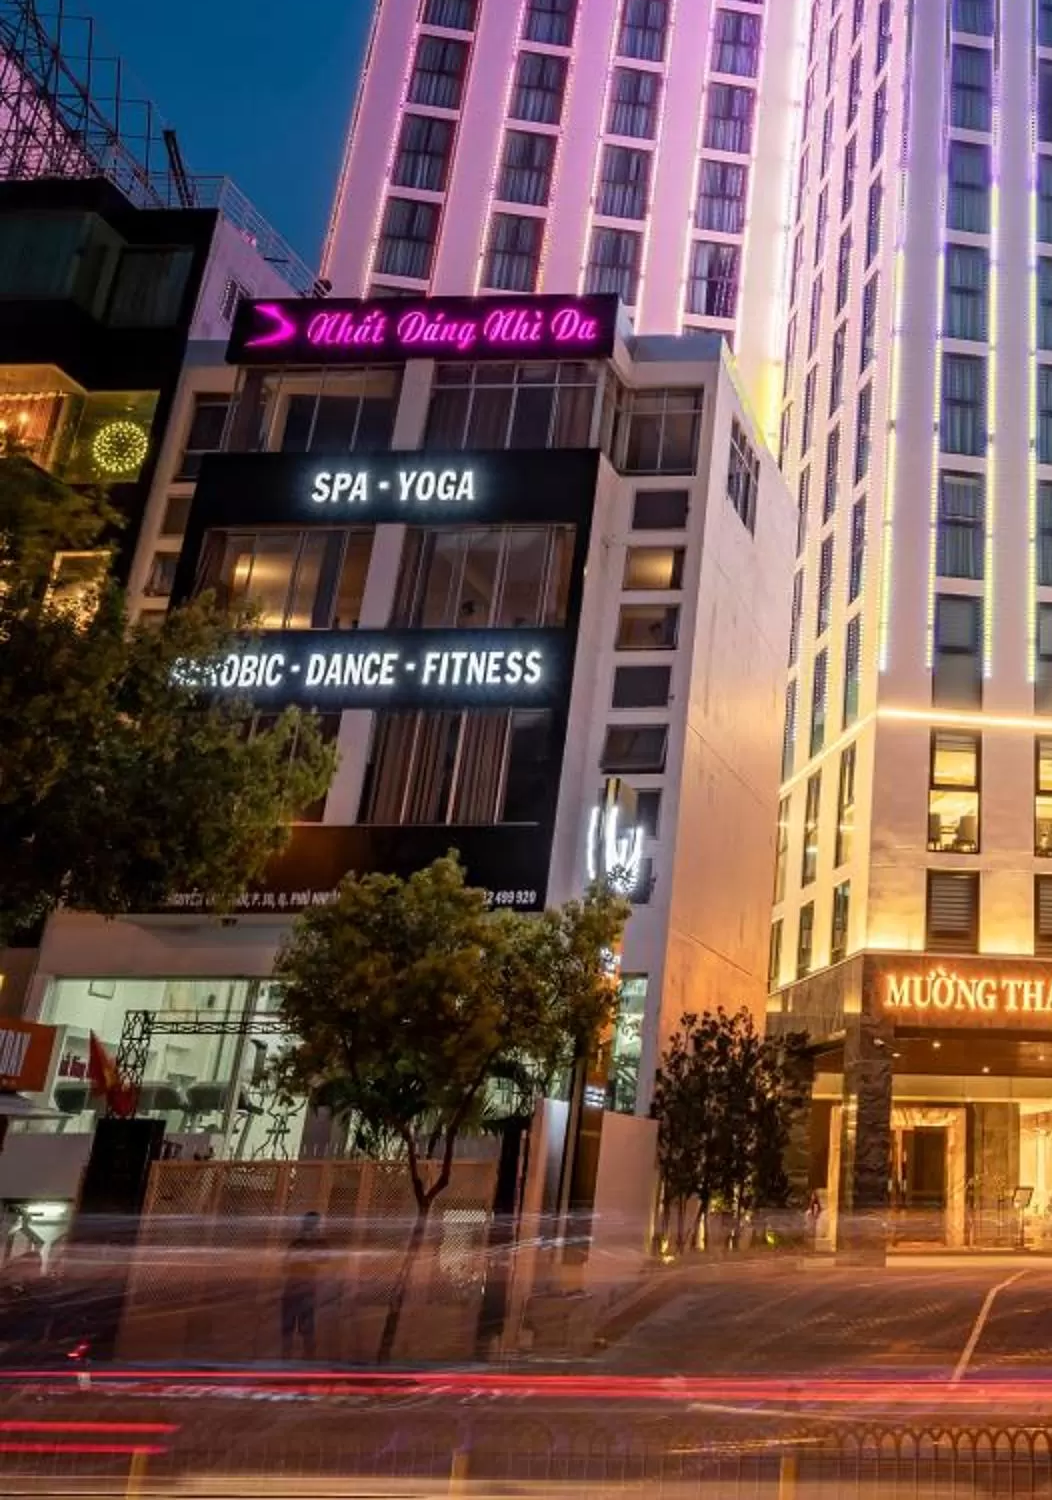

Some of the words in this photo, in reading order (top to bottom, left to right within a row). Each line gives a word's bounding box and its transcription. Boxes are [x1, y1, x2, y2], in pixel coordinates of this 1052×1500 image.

[307, 310, 385, 344] Nhất
[396, 309, 476, 351] Dáng
[483, 308, 541, 342] Nhì
[550, 308, 597, 341] Da
[312, 471, 367, 502] SPA
[399, 470, 474, 501] YOGA
[305, 653, 398, 686] DANCE
[422, 650, 543, 685] FITNESS
[884, 968, 998, 1009] MƯỜNG
